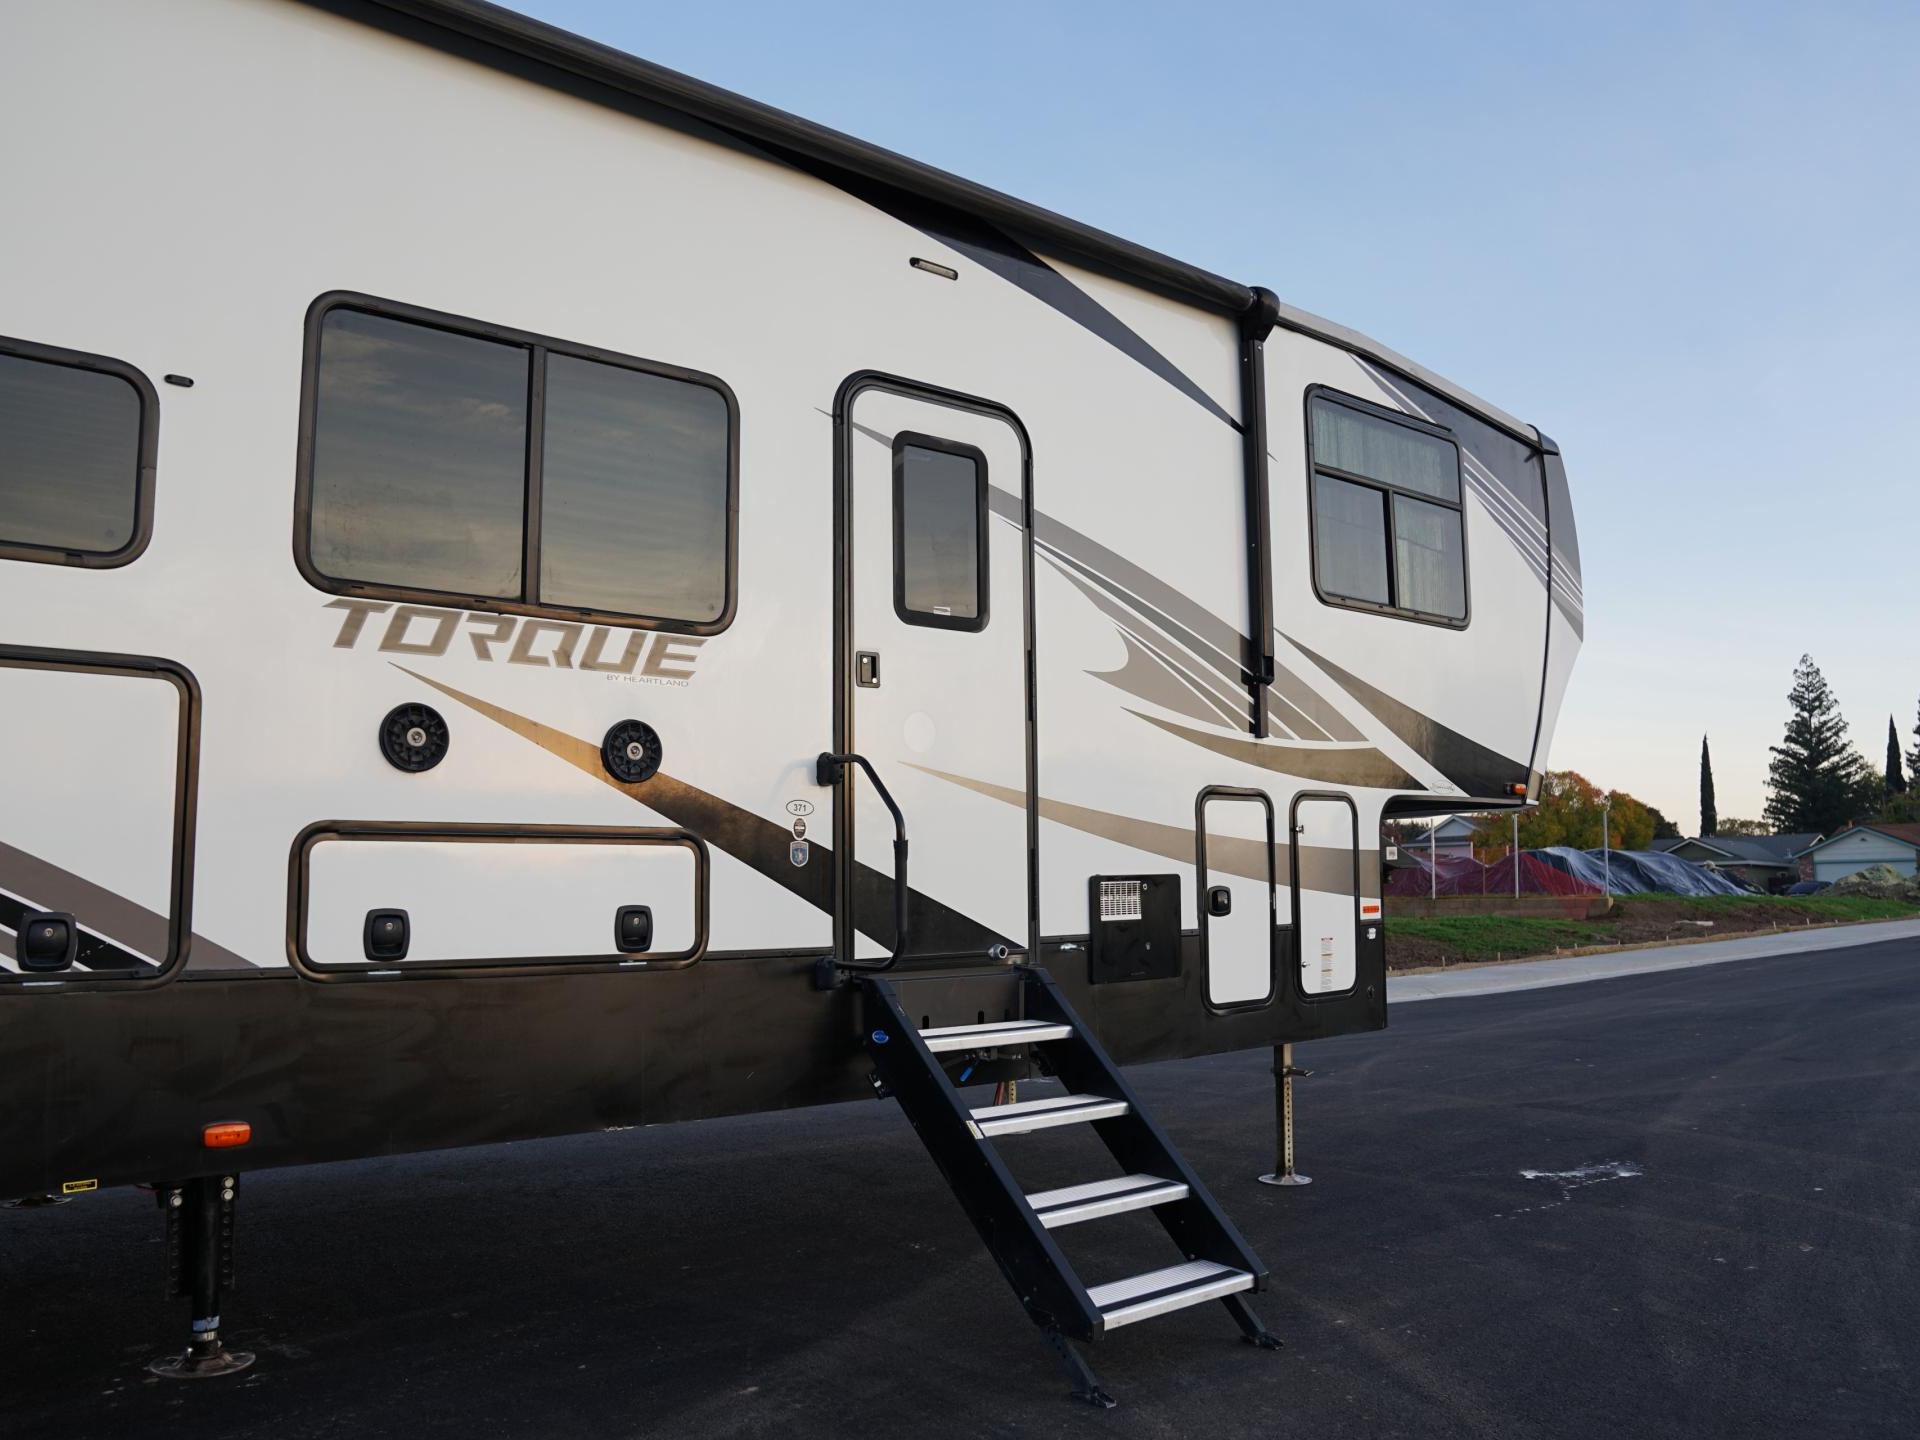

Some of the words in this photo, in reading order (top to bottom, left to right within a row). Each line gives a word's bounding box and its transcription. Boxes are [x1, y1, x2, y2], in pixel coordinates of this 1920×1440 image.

[322, 597, 709, 681] TORQUE
[606, 673, 620, 681] BY
[624, 675, 689, 688] HEARTLAND
[793, 803, 807, 812] 371
